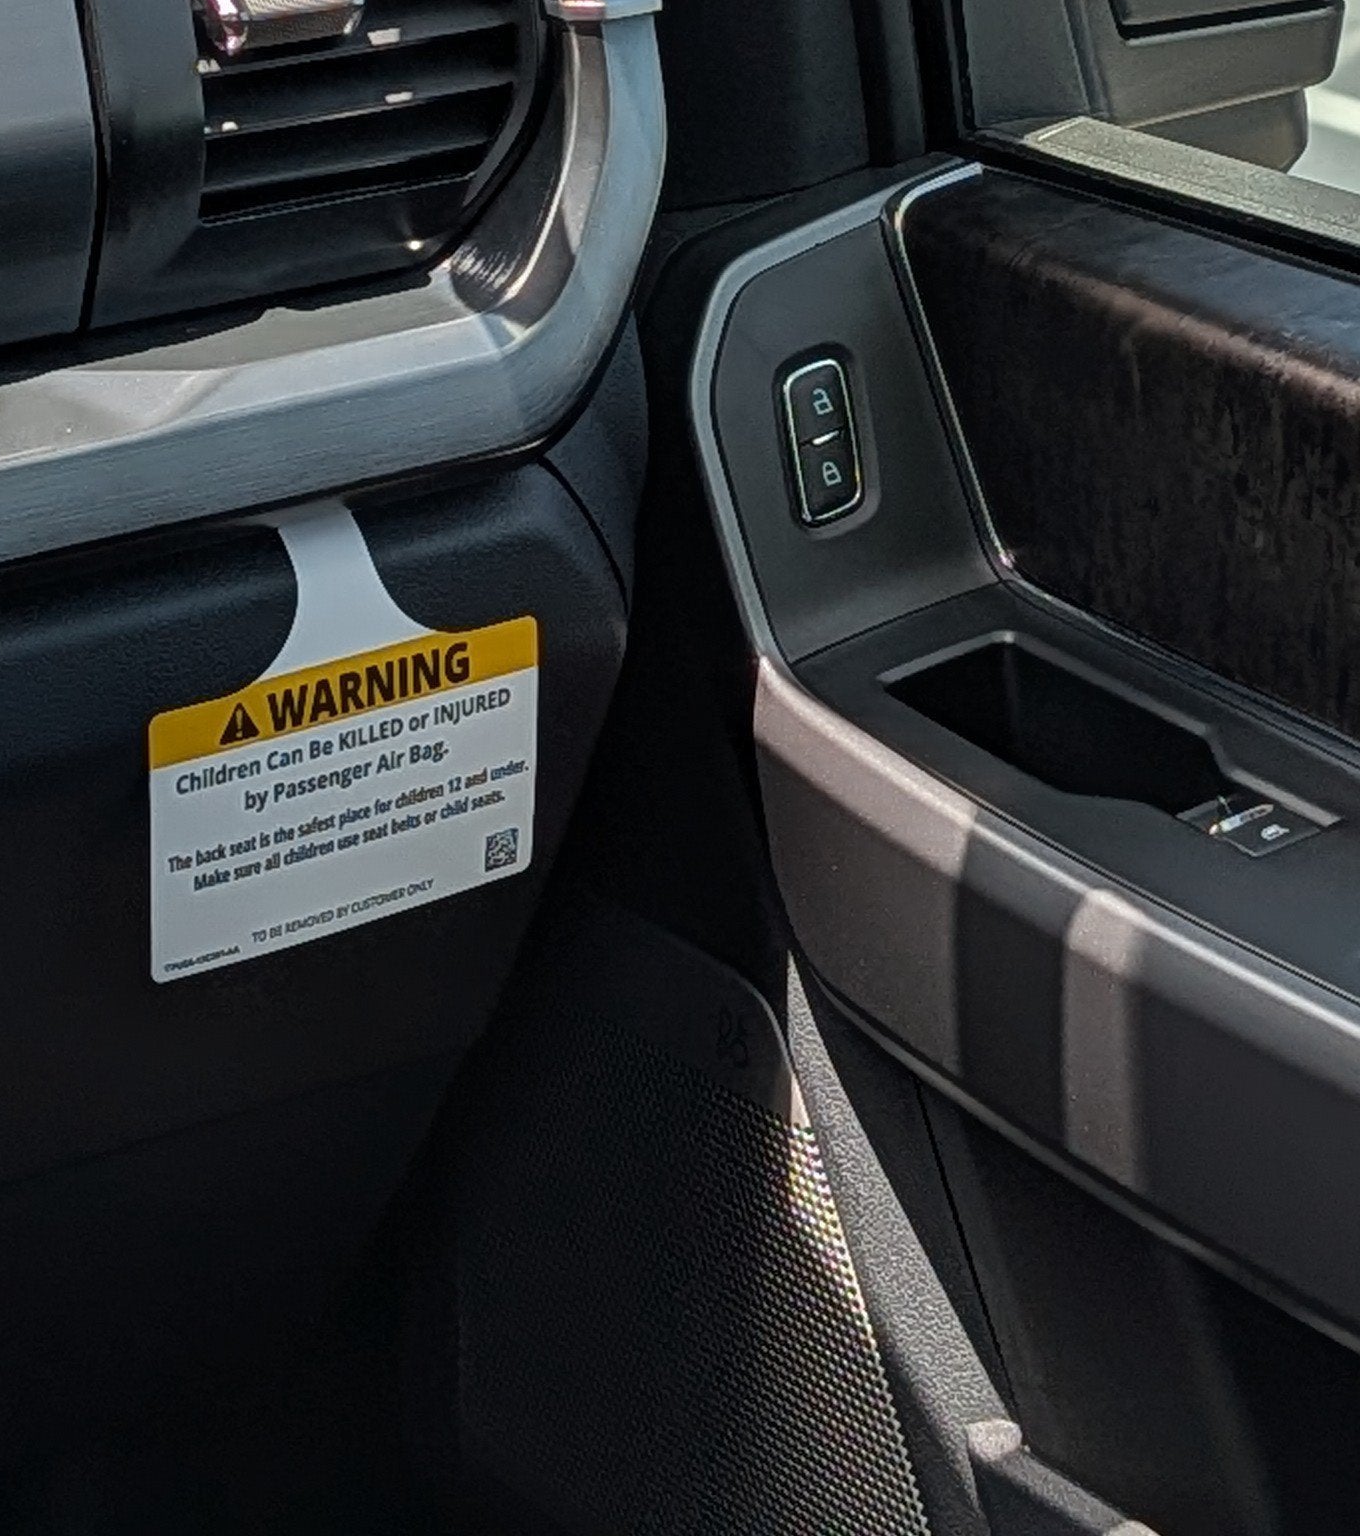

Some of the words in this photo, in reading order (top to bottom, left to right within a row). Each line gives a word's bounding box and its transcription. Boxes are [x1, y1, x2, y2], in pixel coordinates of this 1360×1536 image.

[267, 642, 470, 732] WARNING
[176, 760, 261, 794] Children
[267, 748, 303, 770] Can
[309, 740, 334, 759] Be
[338, 718, 404, 751] KILLED
[408, 713, 429, 731] or
[433, 688, 511, 724] INJURED
[244, 790, 268, 812] by
[274, 762, 372, 802] Passenger
[376, 746, 405, 774] Air
[409, 741, 449, 763] Bag.
[168, 855, 192, 872] The
[196, 844, 226, 866] back
[230, 837, 256, 856] seat
[259, 832, 270, 848] is
[274, 827, 294, 844] the
[298, 815, 336, 837] safest
[339, 806, 371, 830] place
[374, 799, 393, 815] for
[395, 784, 444, 809] children
[448, 777, 462, 794] 12
[465, 767, 488, 789] and
[194, 868, 231, 891] Make
[233, 861, 261, 880] sure
[265, 852, 281, 871] all
[284, 840, 334, 865] children
[337, 833, 360, 850] use
[362, 823, 388, 843] seat
[391, 814, 421, 835] belts
[424, 810, 437, 825] or
[440, 797, 469, 819] child
[251, 929, 267, 943] TO
[269, 925, 282, 939] BE
[285, 910, 334, 934] REMOVED
[336, 904, 350, 918] BY
[351, 887, 406, 914] CUSTOMER
